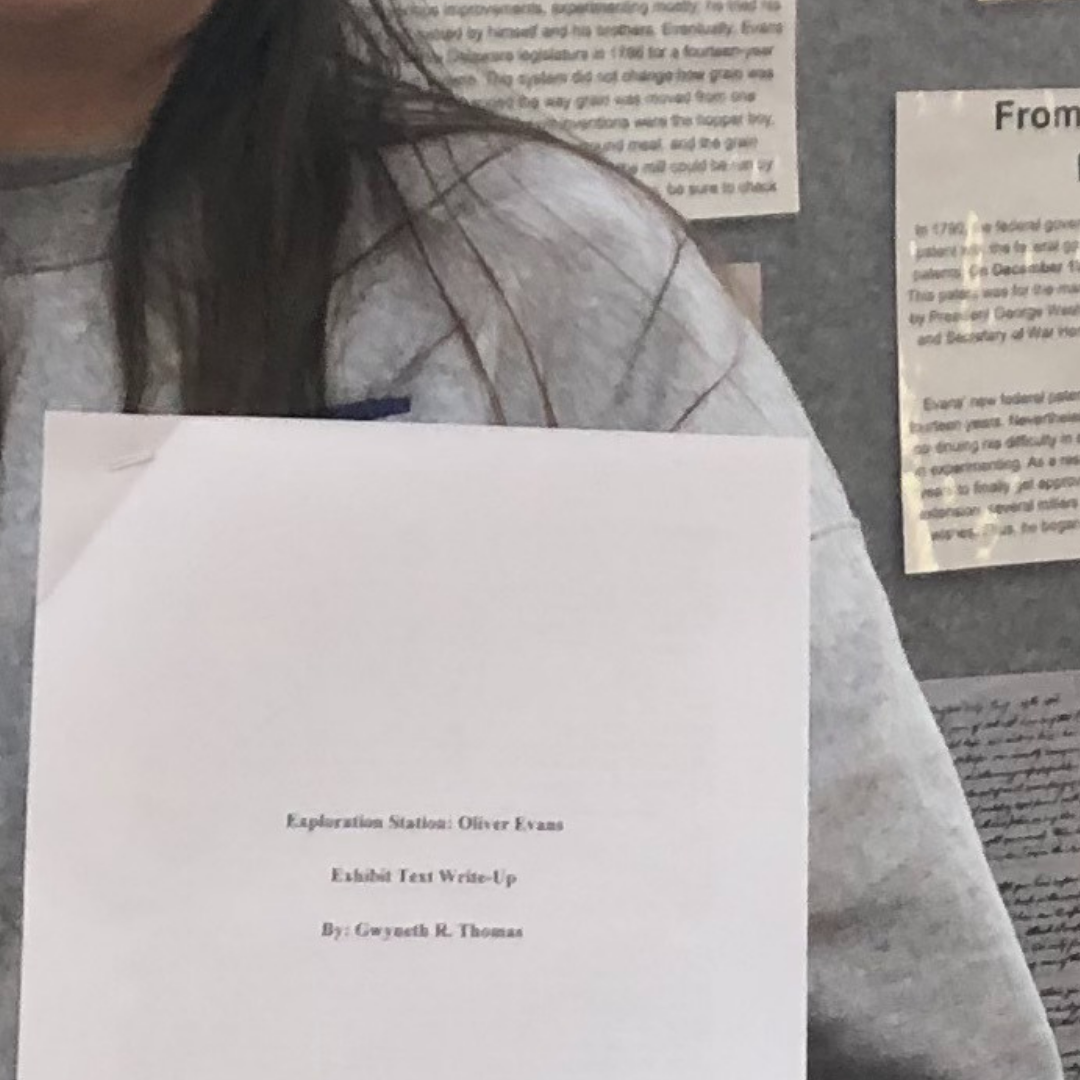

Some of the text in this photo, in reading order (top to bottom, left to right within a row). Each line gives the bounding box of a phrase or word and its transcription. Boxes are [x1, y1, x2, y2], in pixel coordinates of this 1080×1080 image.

[996, 100, 1080, 130] From
[285, 812, 565, 833] Exploration Station: Oliver Evans
[331, 868, 518, 888] Exhibit Text Write-Up
[321, 921, 524, 942] By: Gwyneth R. Thomas
